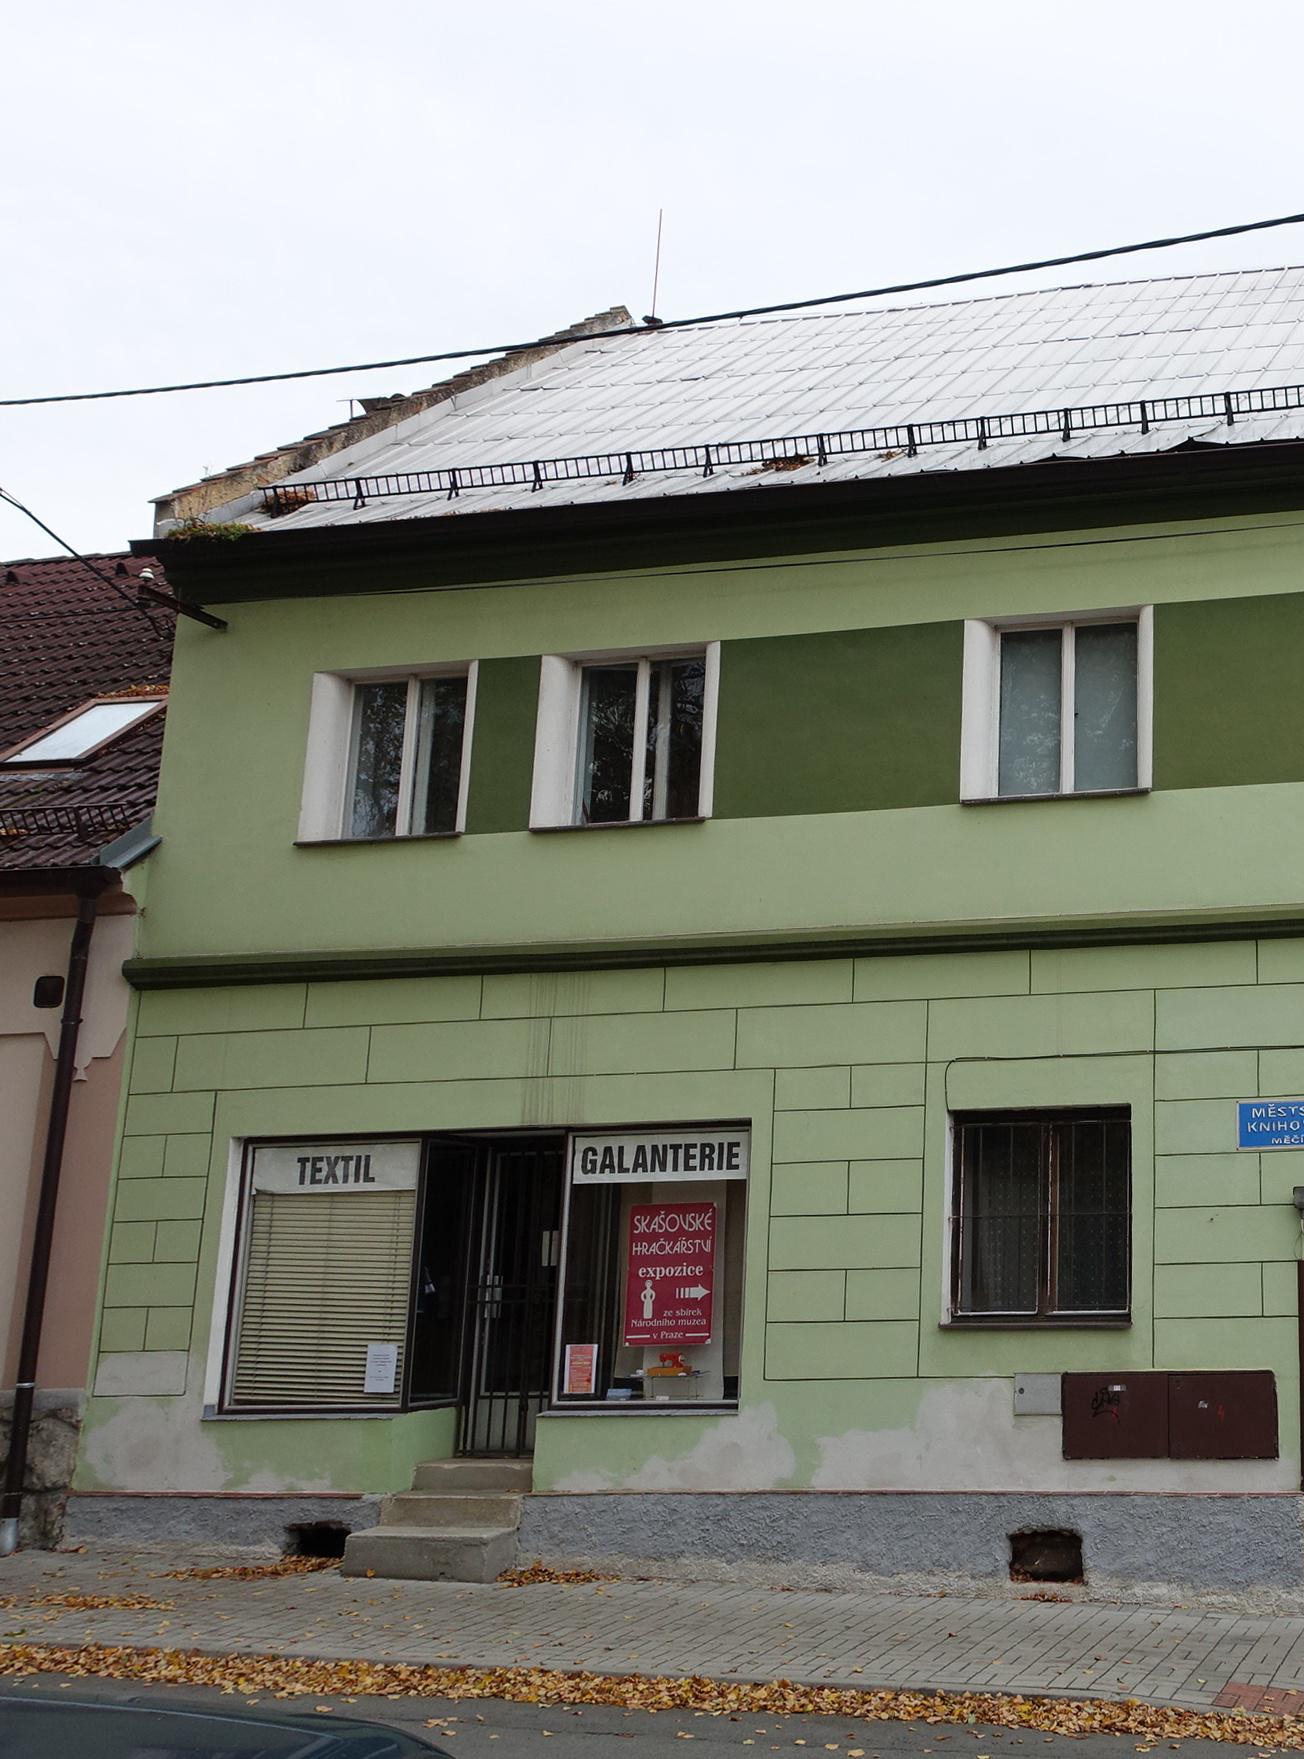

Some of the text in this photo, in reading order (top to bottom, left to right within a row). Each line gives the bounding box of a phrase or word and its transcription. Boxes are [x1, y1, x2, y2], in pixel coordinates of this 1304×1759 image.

[581, 1142, 740, 1174] GALANTERIE
[297, 1154, 375, 1185] TEXTIL
[633, 1209, 712, 1234] SKAŠOVSKÉ
[632, 1236, 712, 1255] HRAČKÁŘSTVÍ
[638, 1262, 704, 1280] expozice
[663, 1307, 702, 1317] ze sbírek
[631, 1317, 706, 1328] Národního muzea
[660, 1330, 684, 1339] Praze
